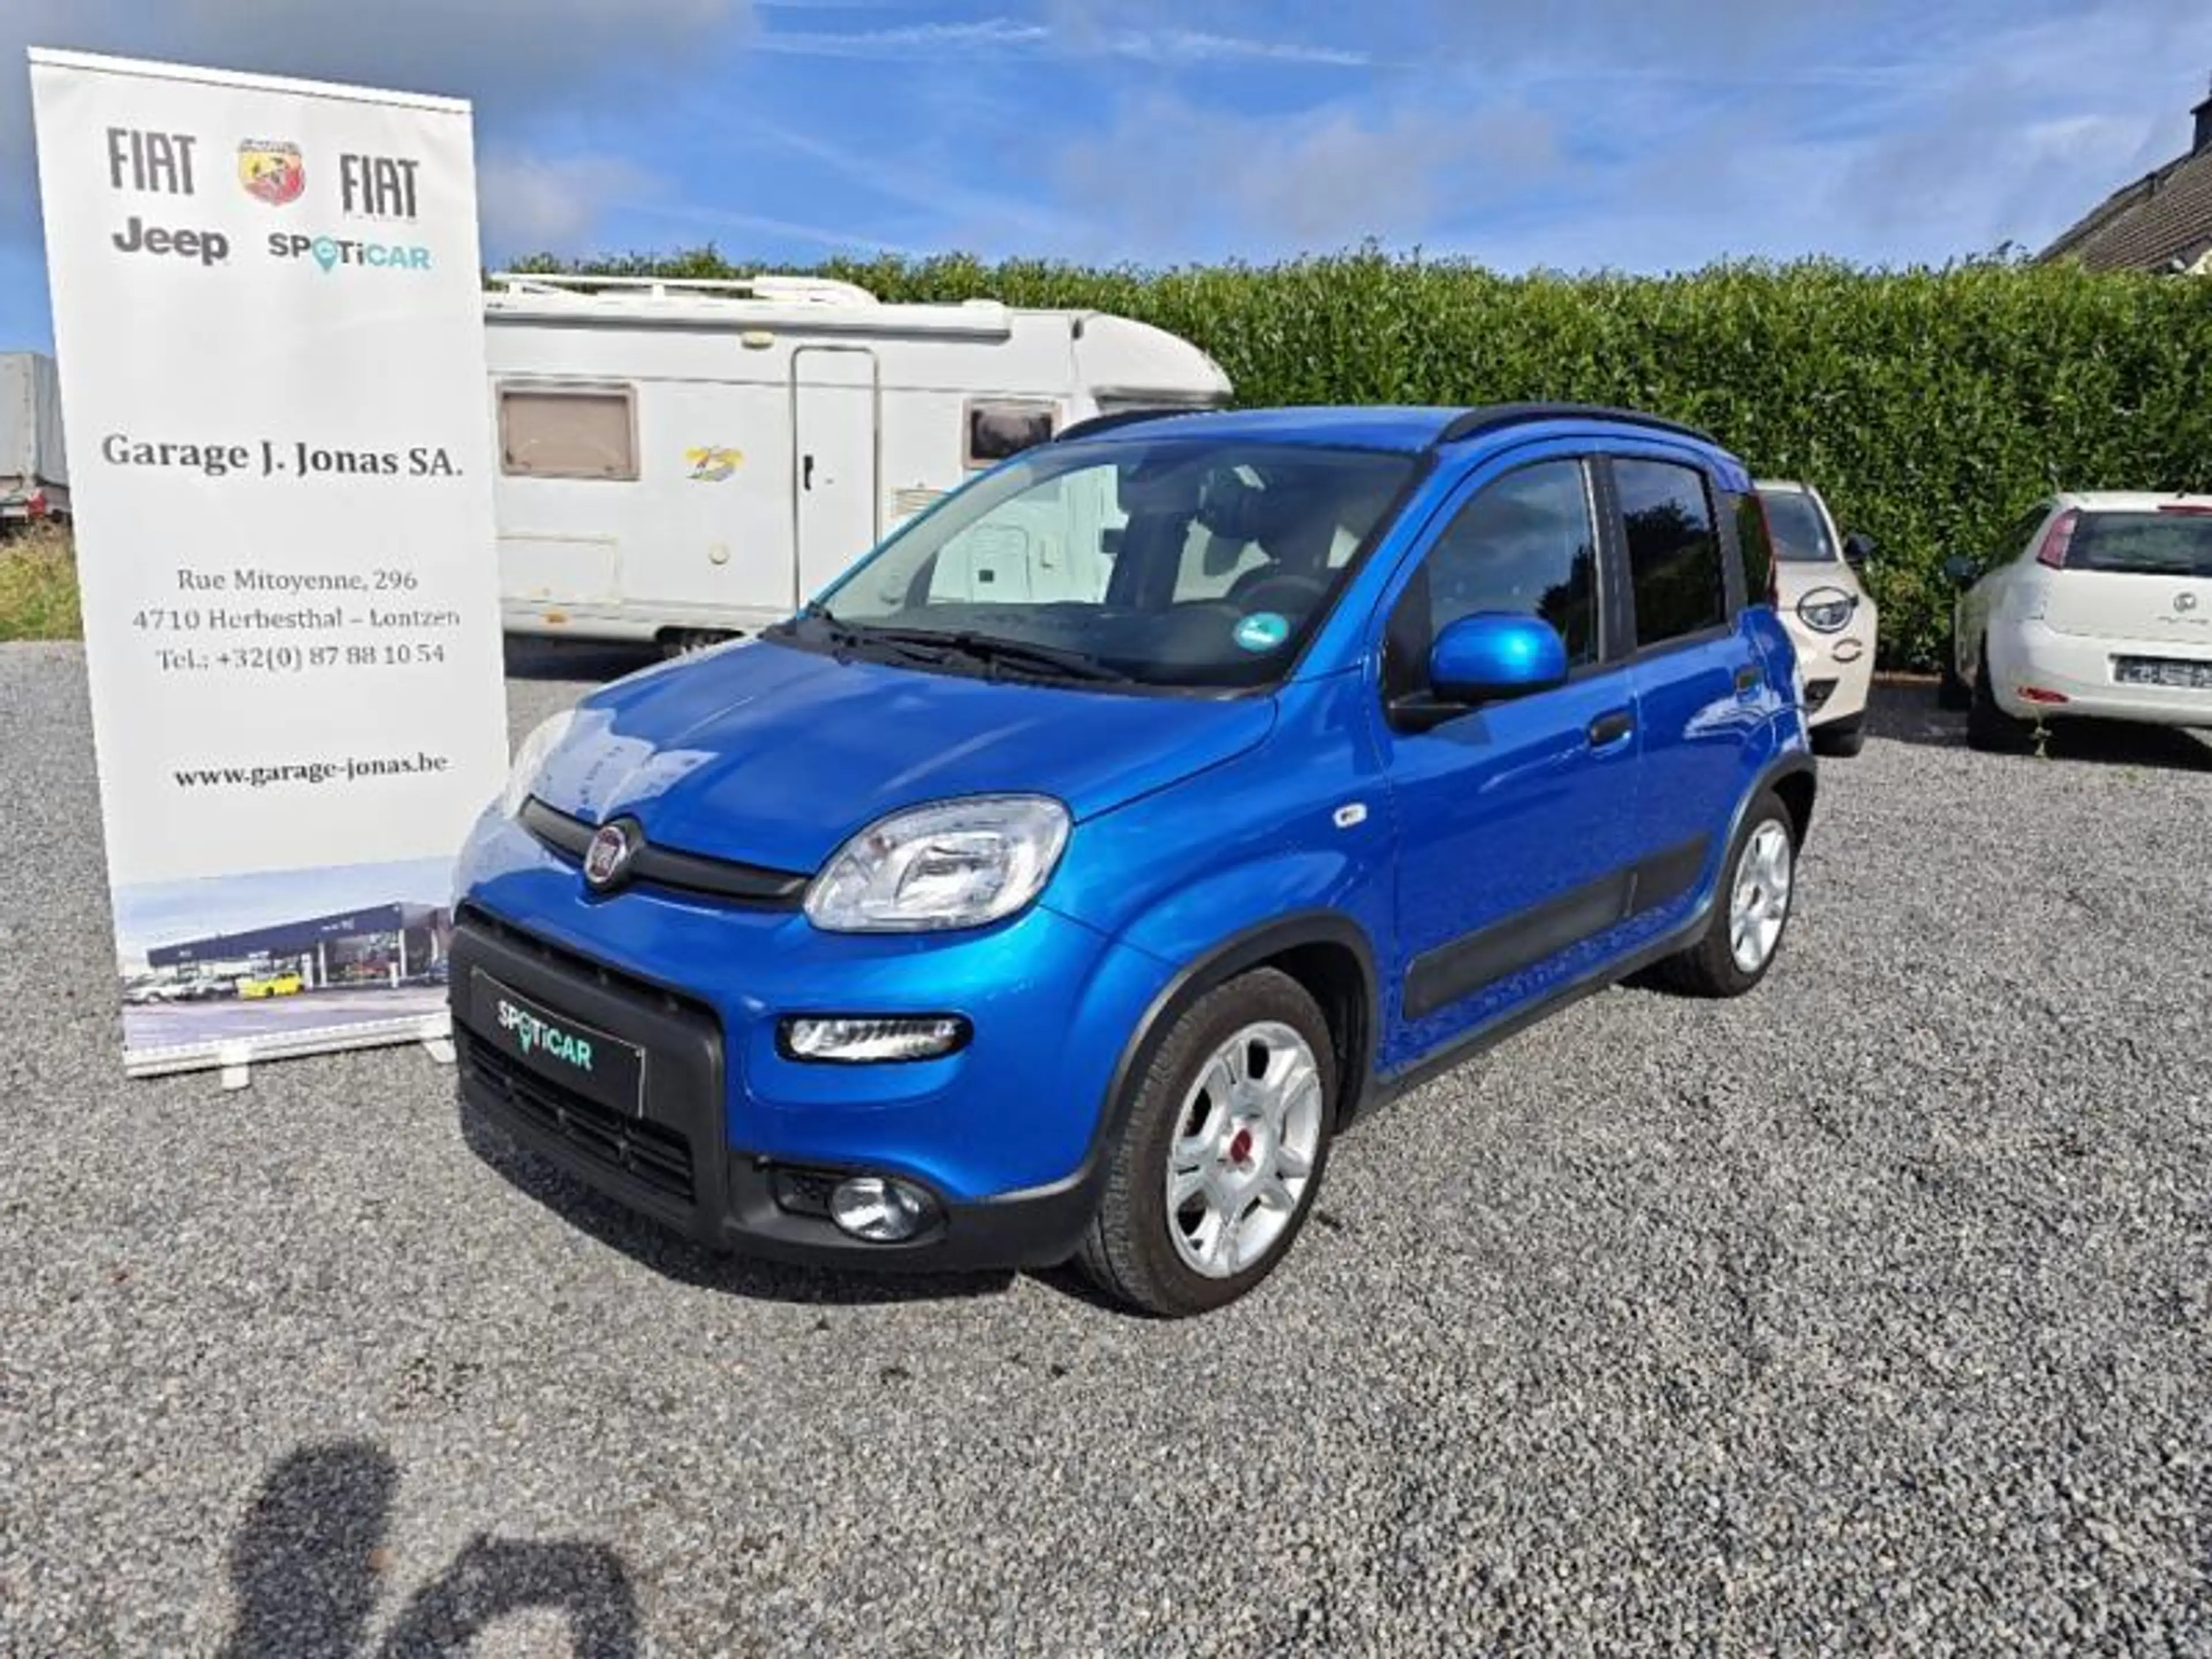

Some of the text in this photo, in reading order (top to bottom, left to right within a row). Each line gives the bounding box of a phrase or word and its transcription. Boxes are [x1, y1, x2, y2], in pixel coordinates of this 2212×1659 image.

[106, 127, 196, 195] FIAT
[340, 153, 419, 217] FIAT
[112, 217, 229, 267] Jeep
[101, 434, 463, 478] Garage J. Jonas SA.
[177, 569, 418, 596] Rue Mitoyenne, 296
[133, 609, 200, 631] 4710
[209, 606, 342, 630] Herbesthal
[370, 608, 460, 627] Lontzen
[217, 647, 302, 672] +32(0)
[309, 646, 339, 666] 87
[346, 646, 377, 665] 88
[385, 644, 410, 665] 10
[417, 644, 445, 663] 54
[174, 753, 447, 786] www.garage-jonas.be
